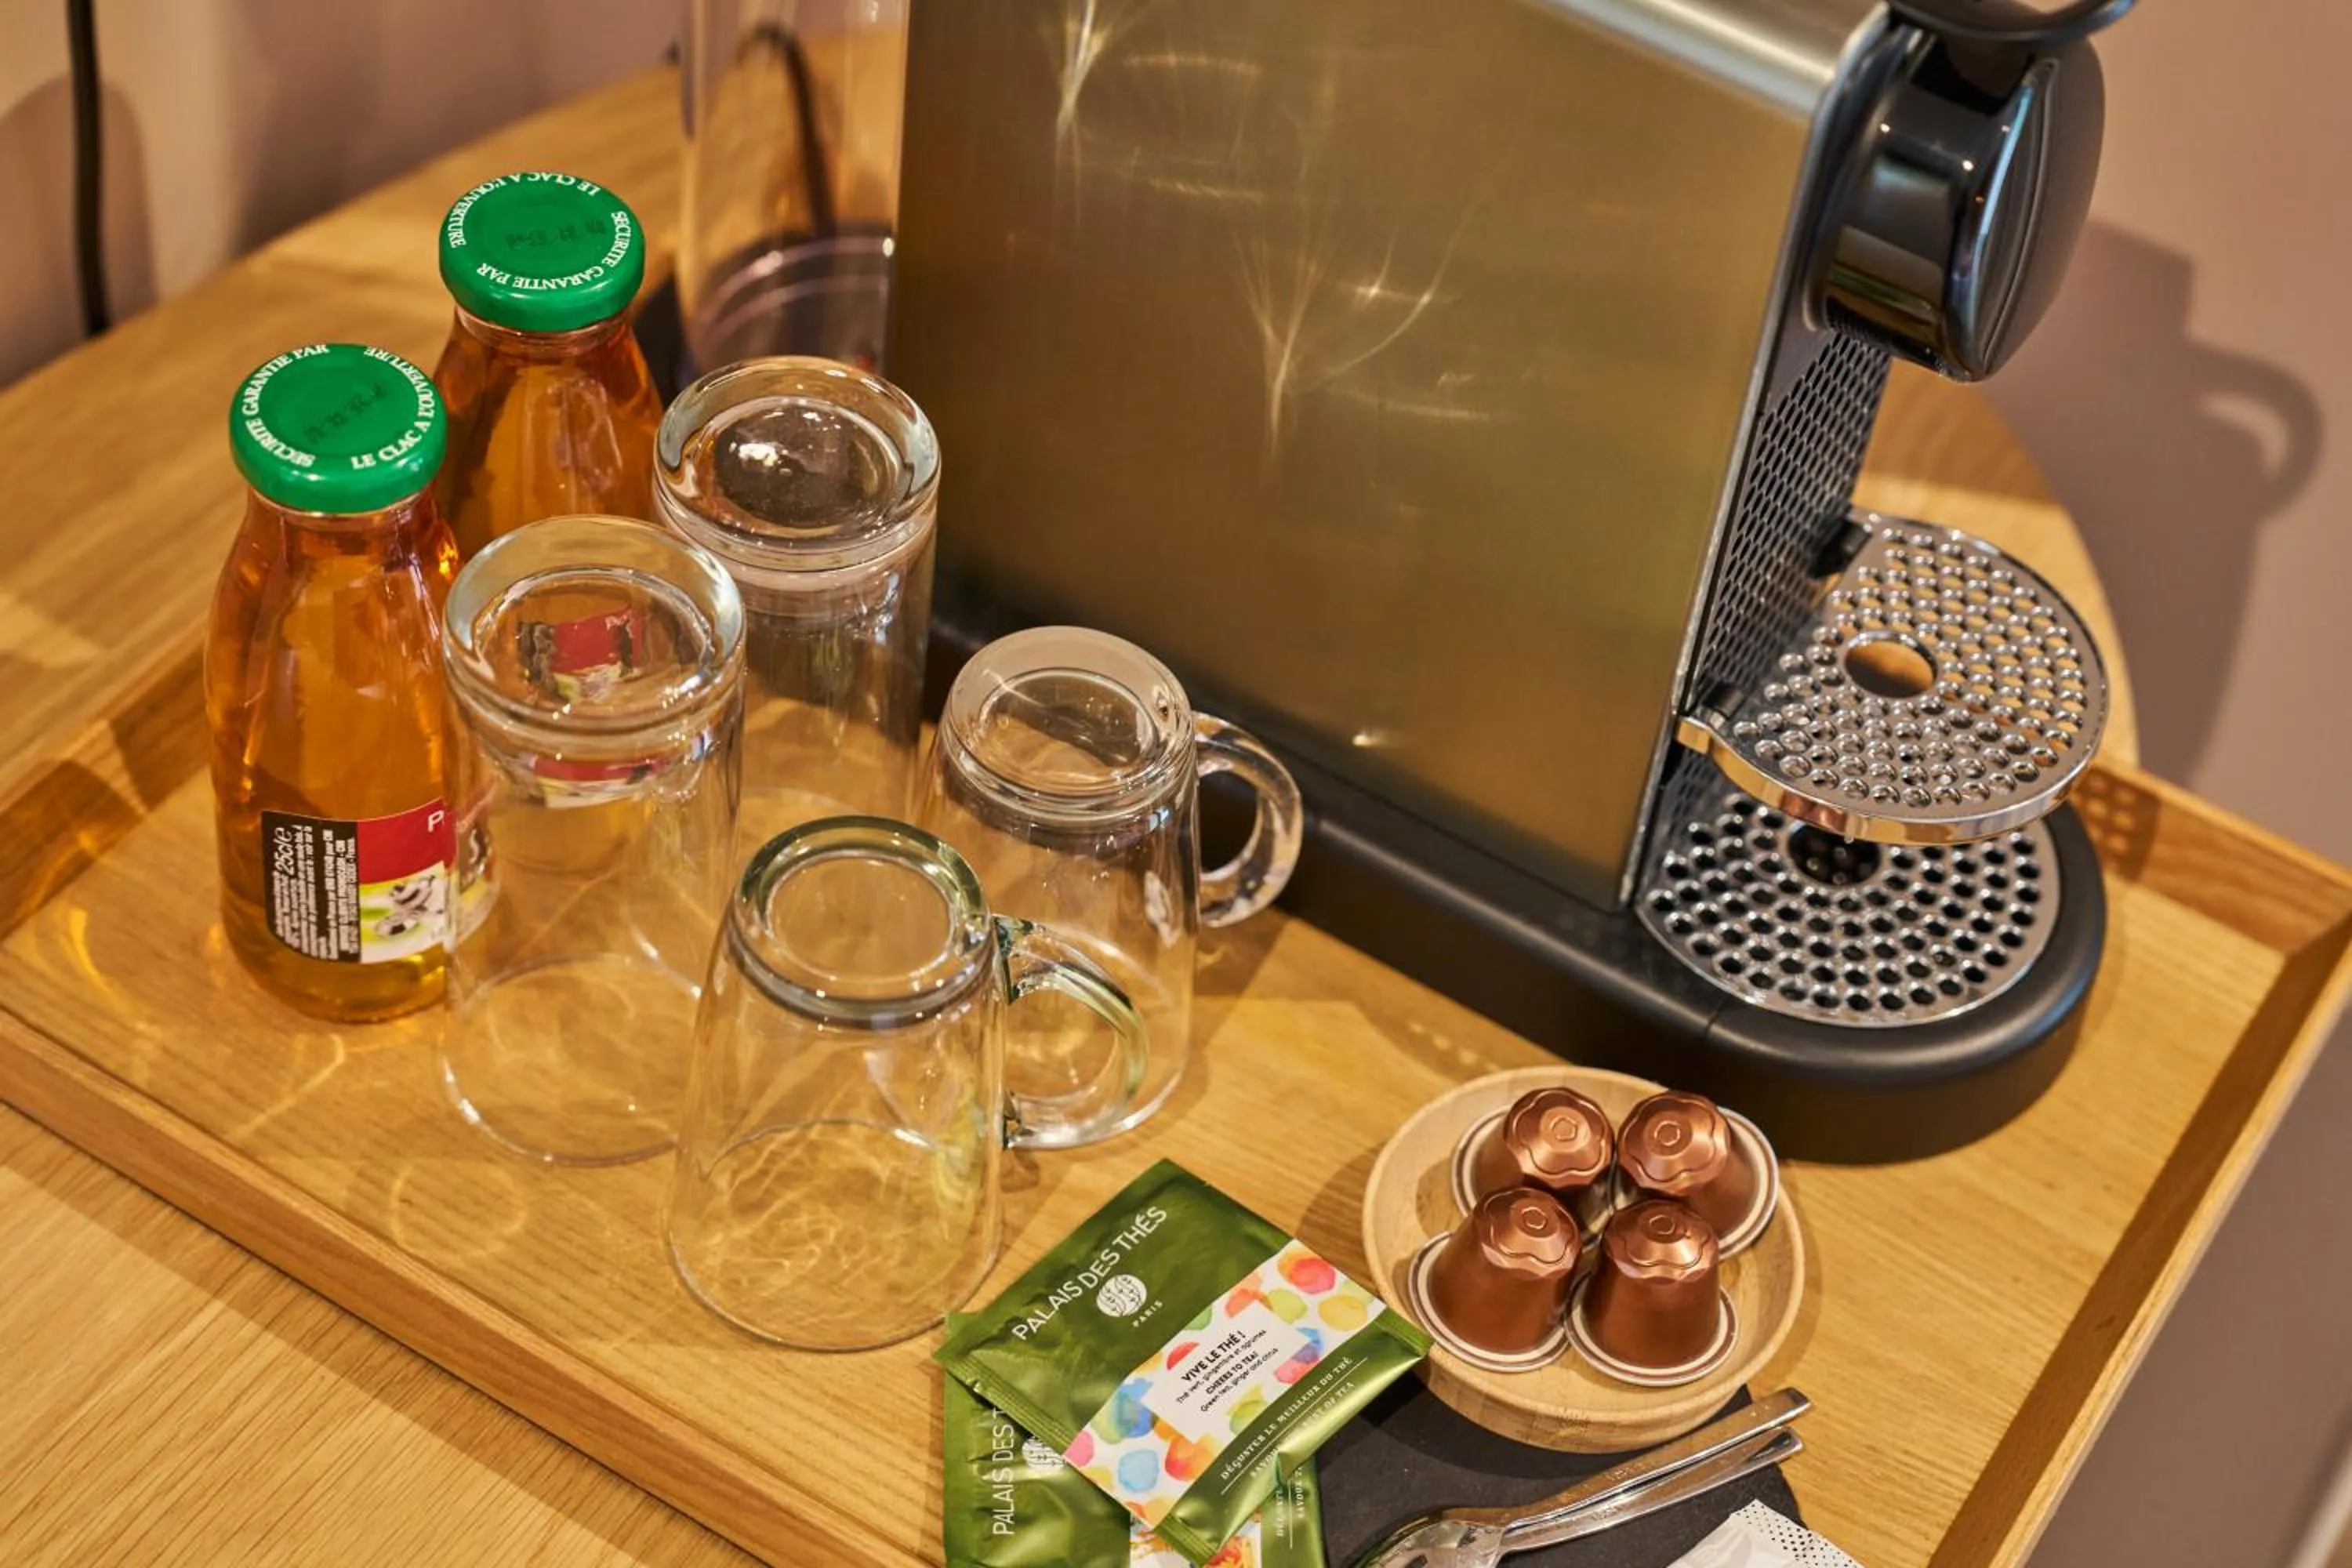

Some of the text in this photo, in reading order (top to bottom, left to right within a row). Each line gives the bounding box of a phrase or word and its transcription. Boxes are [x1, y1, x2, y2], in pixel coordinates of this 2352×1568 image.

[528, 172, 576, 185] CLAC
[577, 180, 601, 196] LE
[602, 210, 631, 267] SECURITE
[476, 263, 511, 285] PAR
[513, 265, 604, 289] GARANTIE
[241, 344, 330, 468] SECURITE GARANTIE PAR
[351, 453, 377, 470] LE
[378, 429, 423, 462] CLAC
[414, 421, 431, 432] A
[1011, 1206, 1168, 1341] PALAIS DES THÉS
[1132, 1300, 1163, 1327] PARIS
[1181, 1360, 1209, 1382] VIVE
[1205, 1348, 1221, 1364] LE
[1216, 1332, 1241, 1352] THÉ
[1205, 1370, 1234, 1395] CHEERS
[1231, 1363, 1243, 1374] TO
[1276, 1385, 1321, 1424] MEILLEUR
[992, 1423, 1015, 1462] DES
[992, 1467, 1015, 1536] PALAIS
